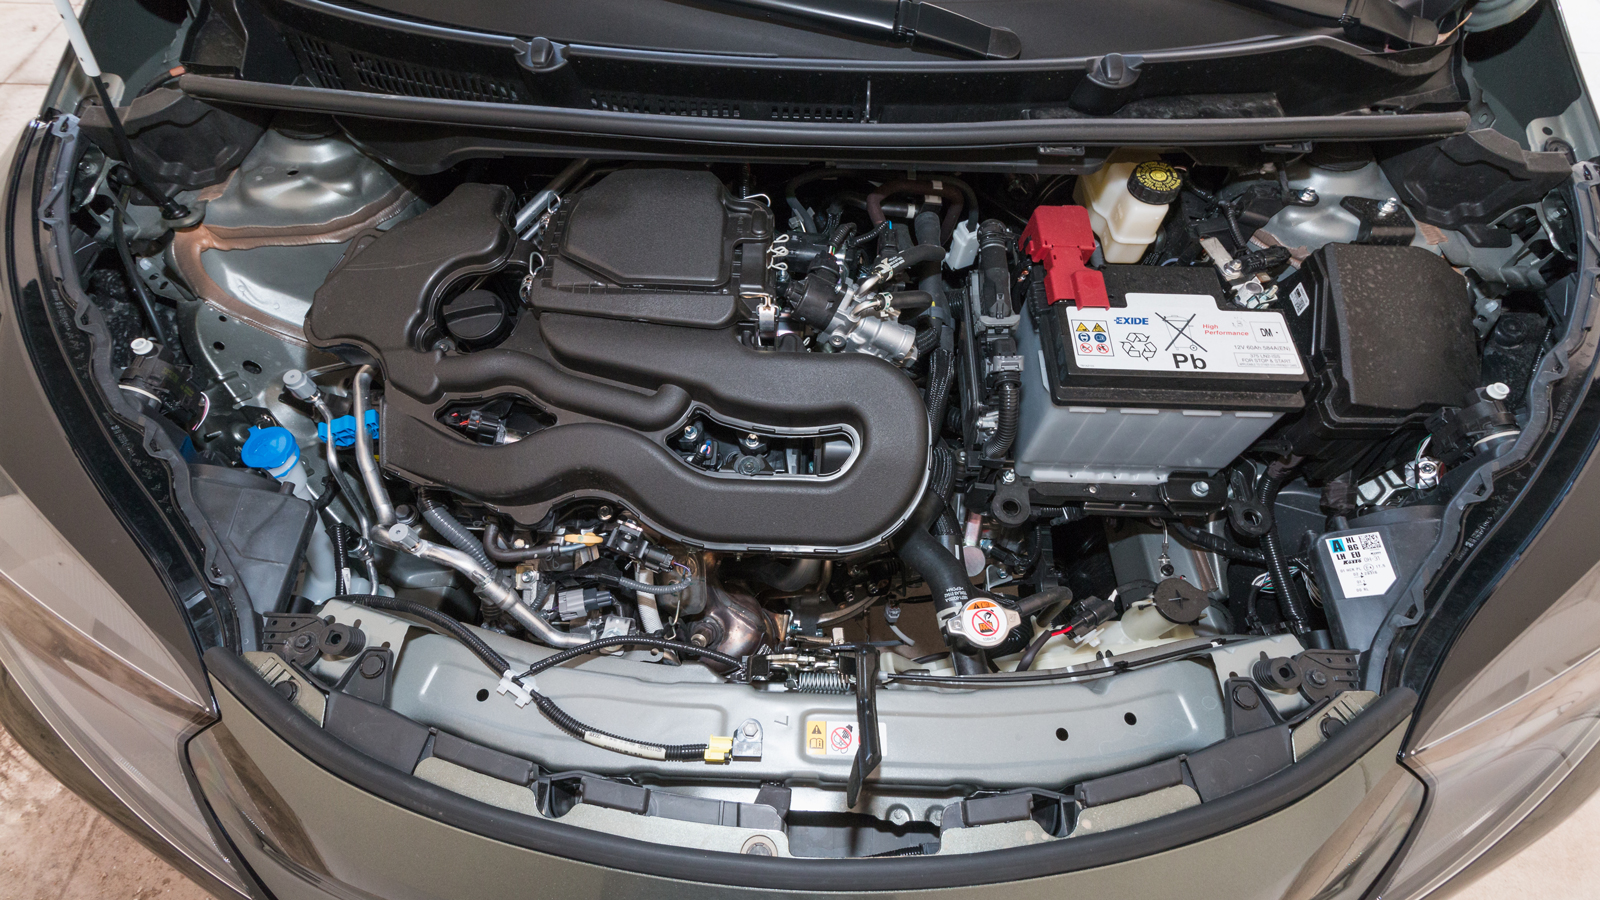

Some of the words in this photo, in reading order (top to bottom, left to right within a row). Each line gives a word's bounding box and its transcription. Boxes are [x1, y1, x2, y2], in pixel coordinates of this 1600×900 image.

[1114, 317, 1149, 325] EXIDE
[1260, 328, 1273, 337] DM
[1172, 353, 1207, 370] Pb
[1332, 540, 1345, 552] A
